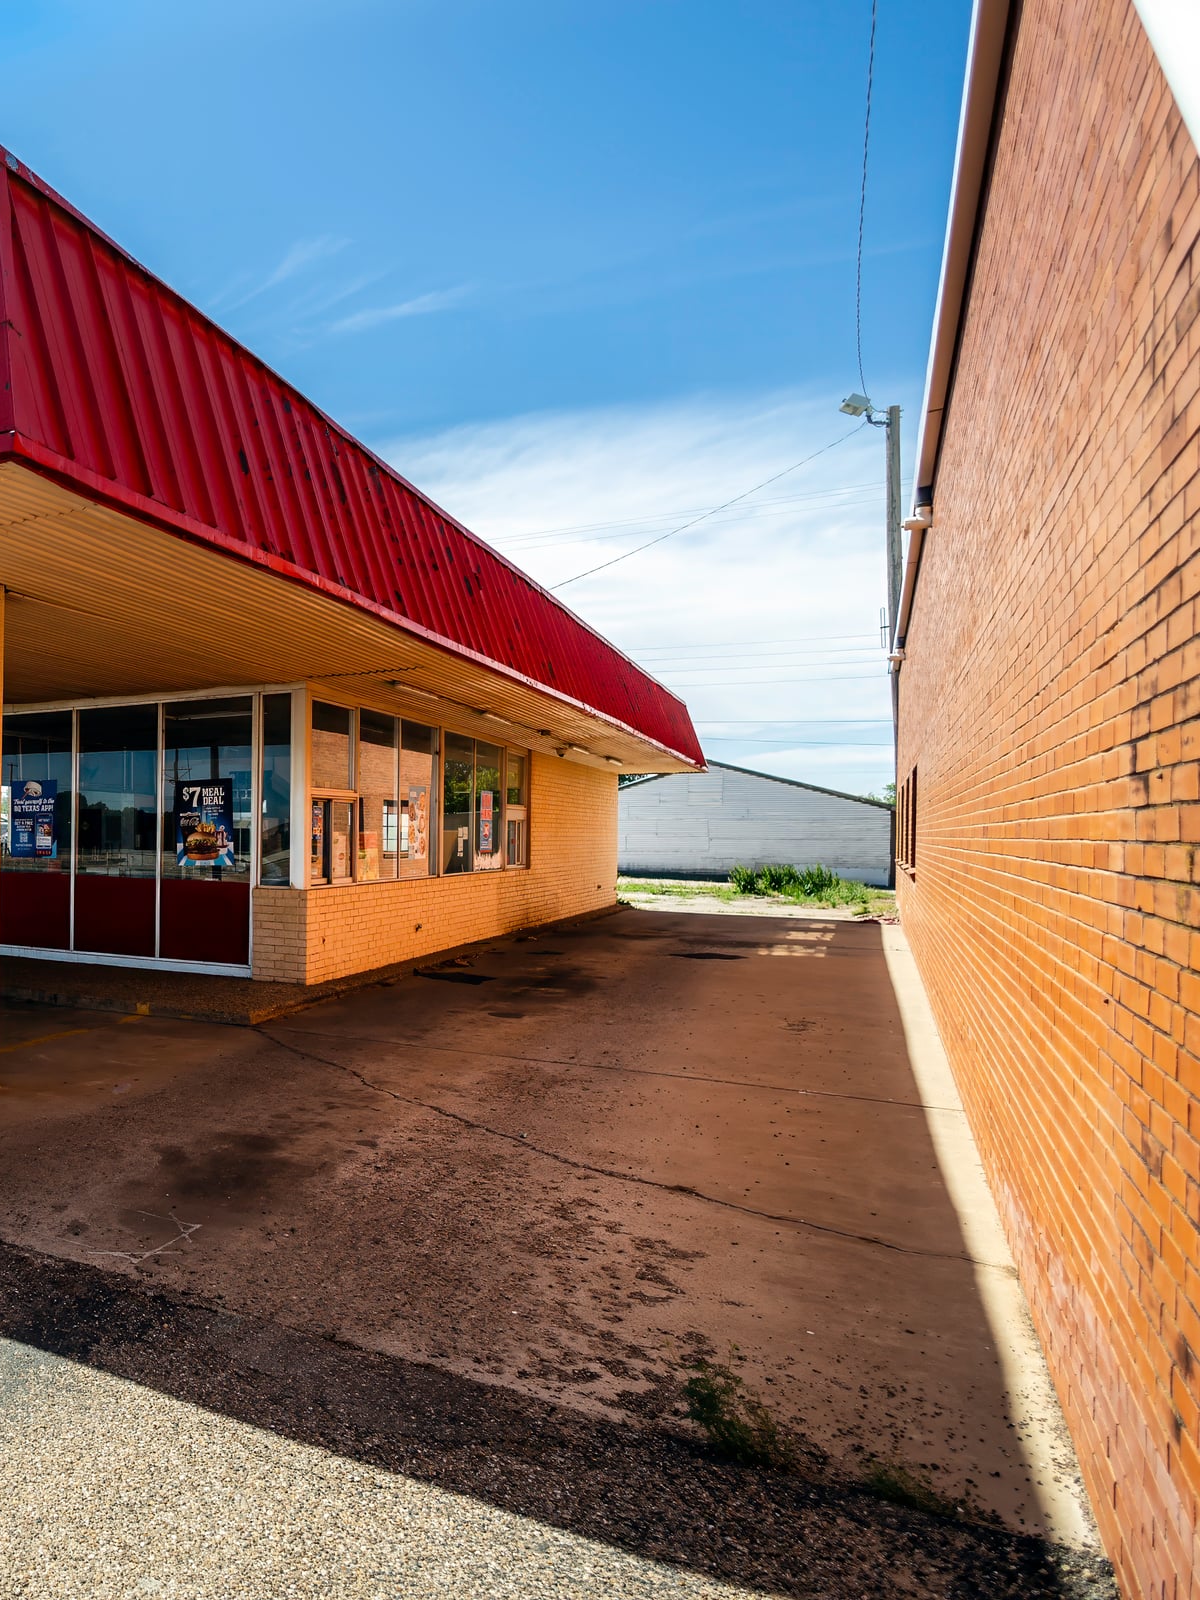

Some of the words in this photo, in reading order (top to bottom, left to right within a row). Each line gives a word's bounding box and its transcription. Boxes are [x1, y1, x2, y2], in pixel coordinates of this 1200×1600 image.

[182, 786, 201, 807] $7
[202, 787, 225, 796] MEAL
[203, 796, 224, 806] DEAL
